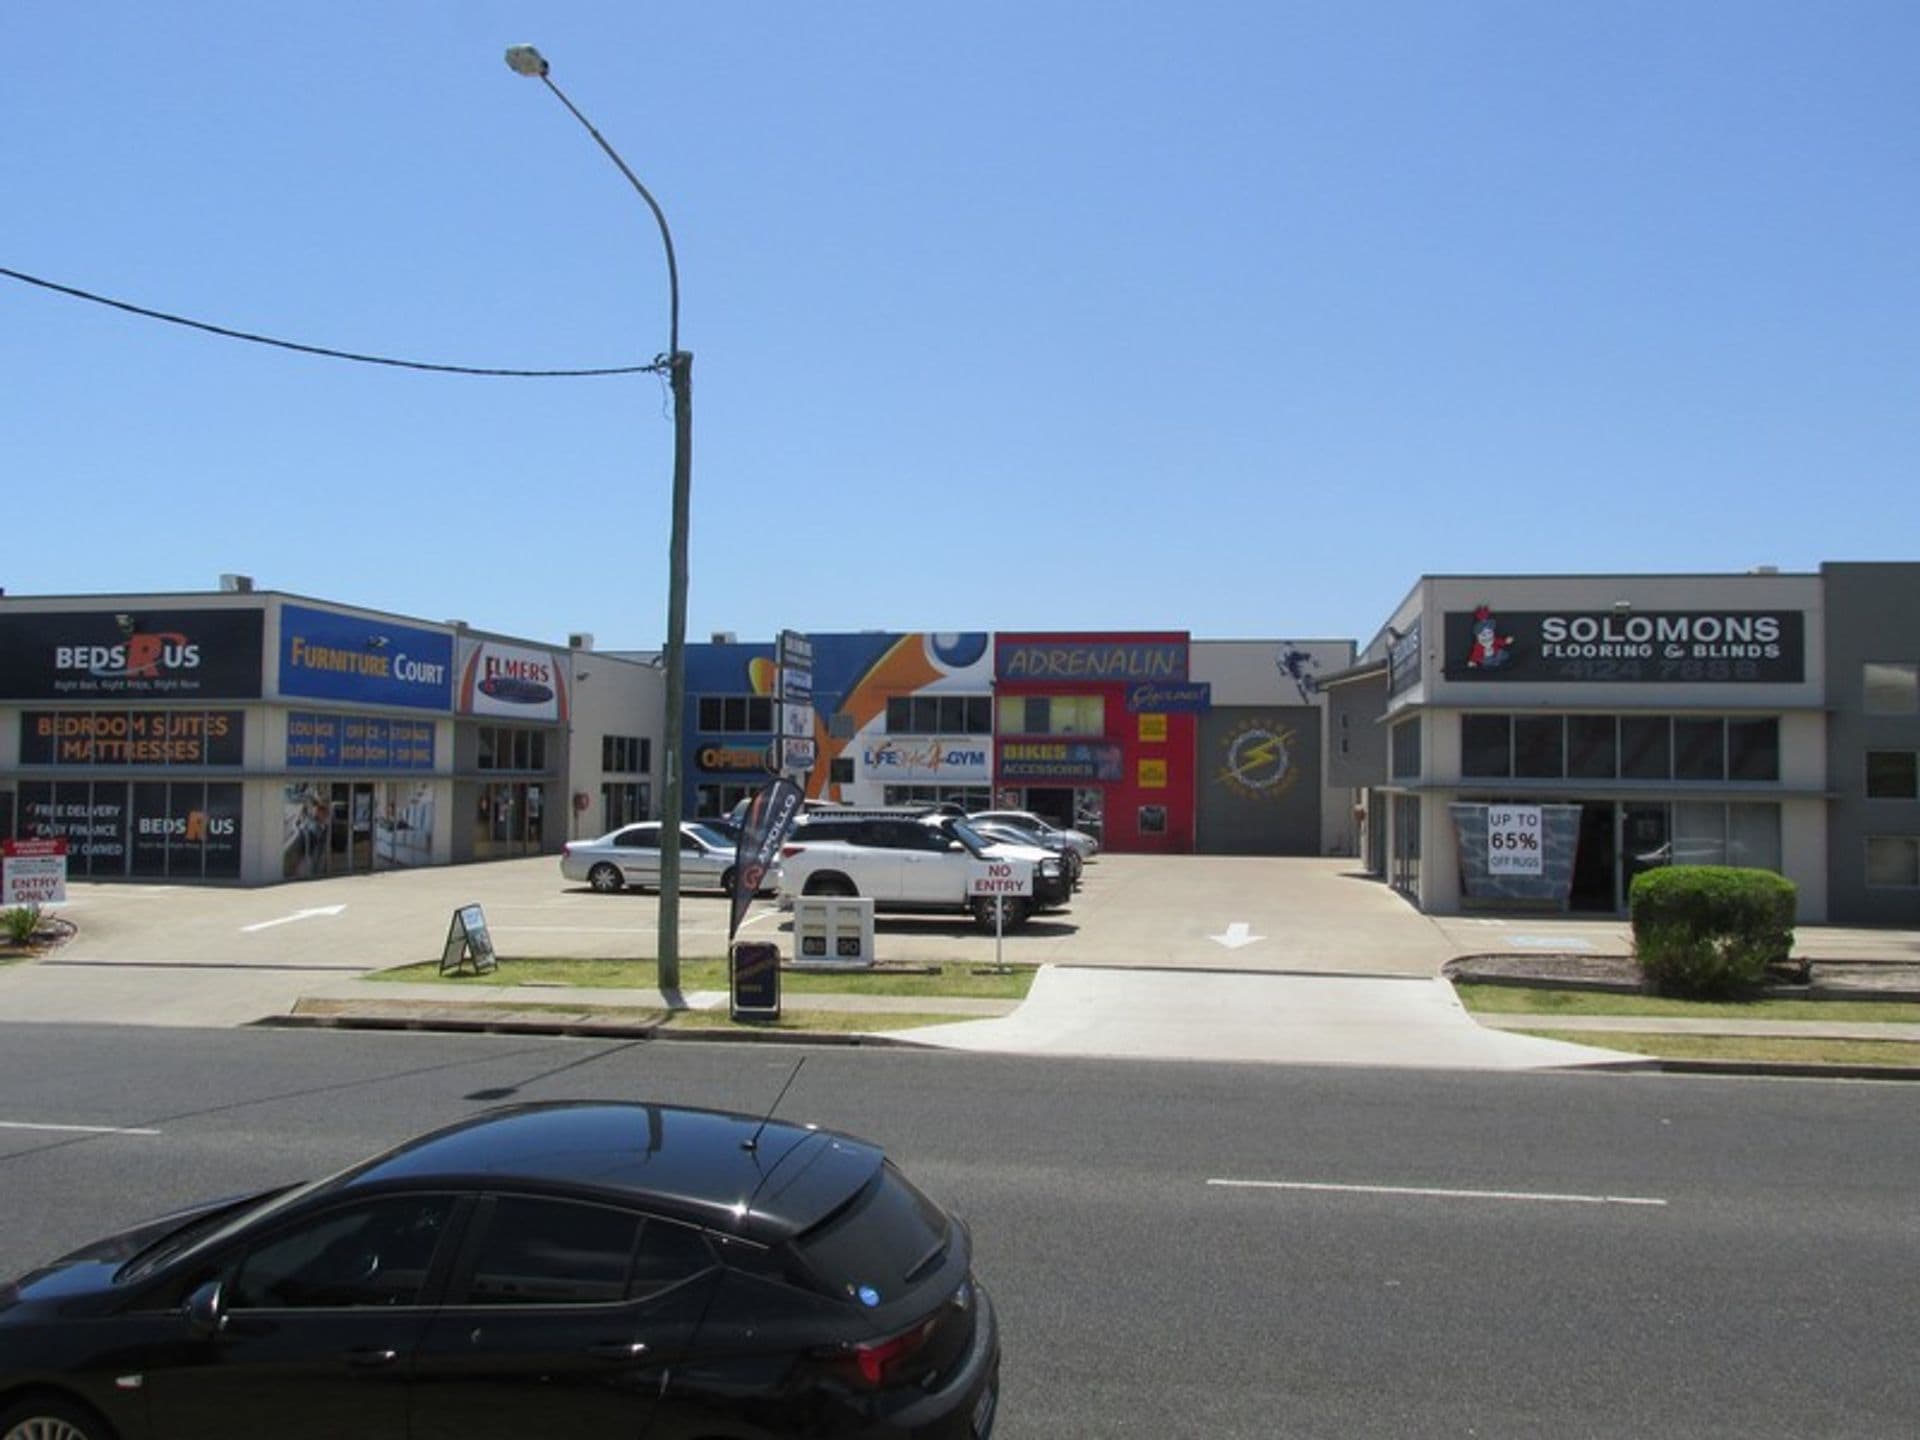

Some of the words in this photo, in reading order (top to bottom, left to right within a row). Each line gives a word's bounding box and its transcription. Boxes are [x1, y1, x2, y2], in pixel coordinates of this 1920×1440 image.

[1542, 616, 1780, 642] SOLOMONS
[56, 645, 126, 668] BEDS
[164, 645, 200, 667] US
[1543, 643, 1652, 658] FLOORING
[1693, 643, 1780, 658] BLINDS
[292, 637, 389, 677] FURNITURE
[394, 653, 445, 684] COURT
[1008, 649, 1176, 674] ADRENALIN
[38, 716, 145, 735] BEDROOM
[152, 716, 229, 736] SUITES
[63, 740, 200, 760] MATTRESSES
[1003, 744, 1067, 760] BIKES
[139, 818, 186, 834] BEDS
[210, 818, 234, 834] US
[1490, 813, 1511, 827] UP
[1517, 813, 1537, 827] TO
[1492, 832, 1537, 850] 65%
[989, 864, 1012, 877] NO
[12, 877, 58, 889] ENTRY
[975, 880, 1024, 891] ENTRY
[15, 889, 54, 902] ONLY
